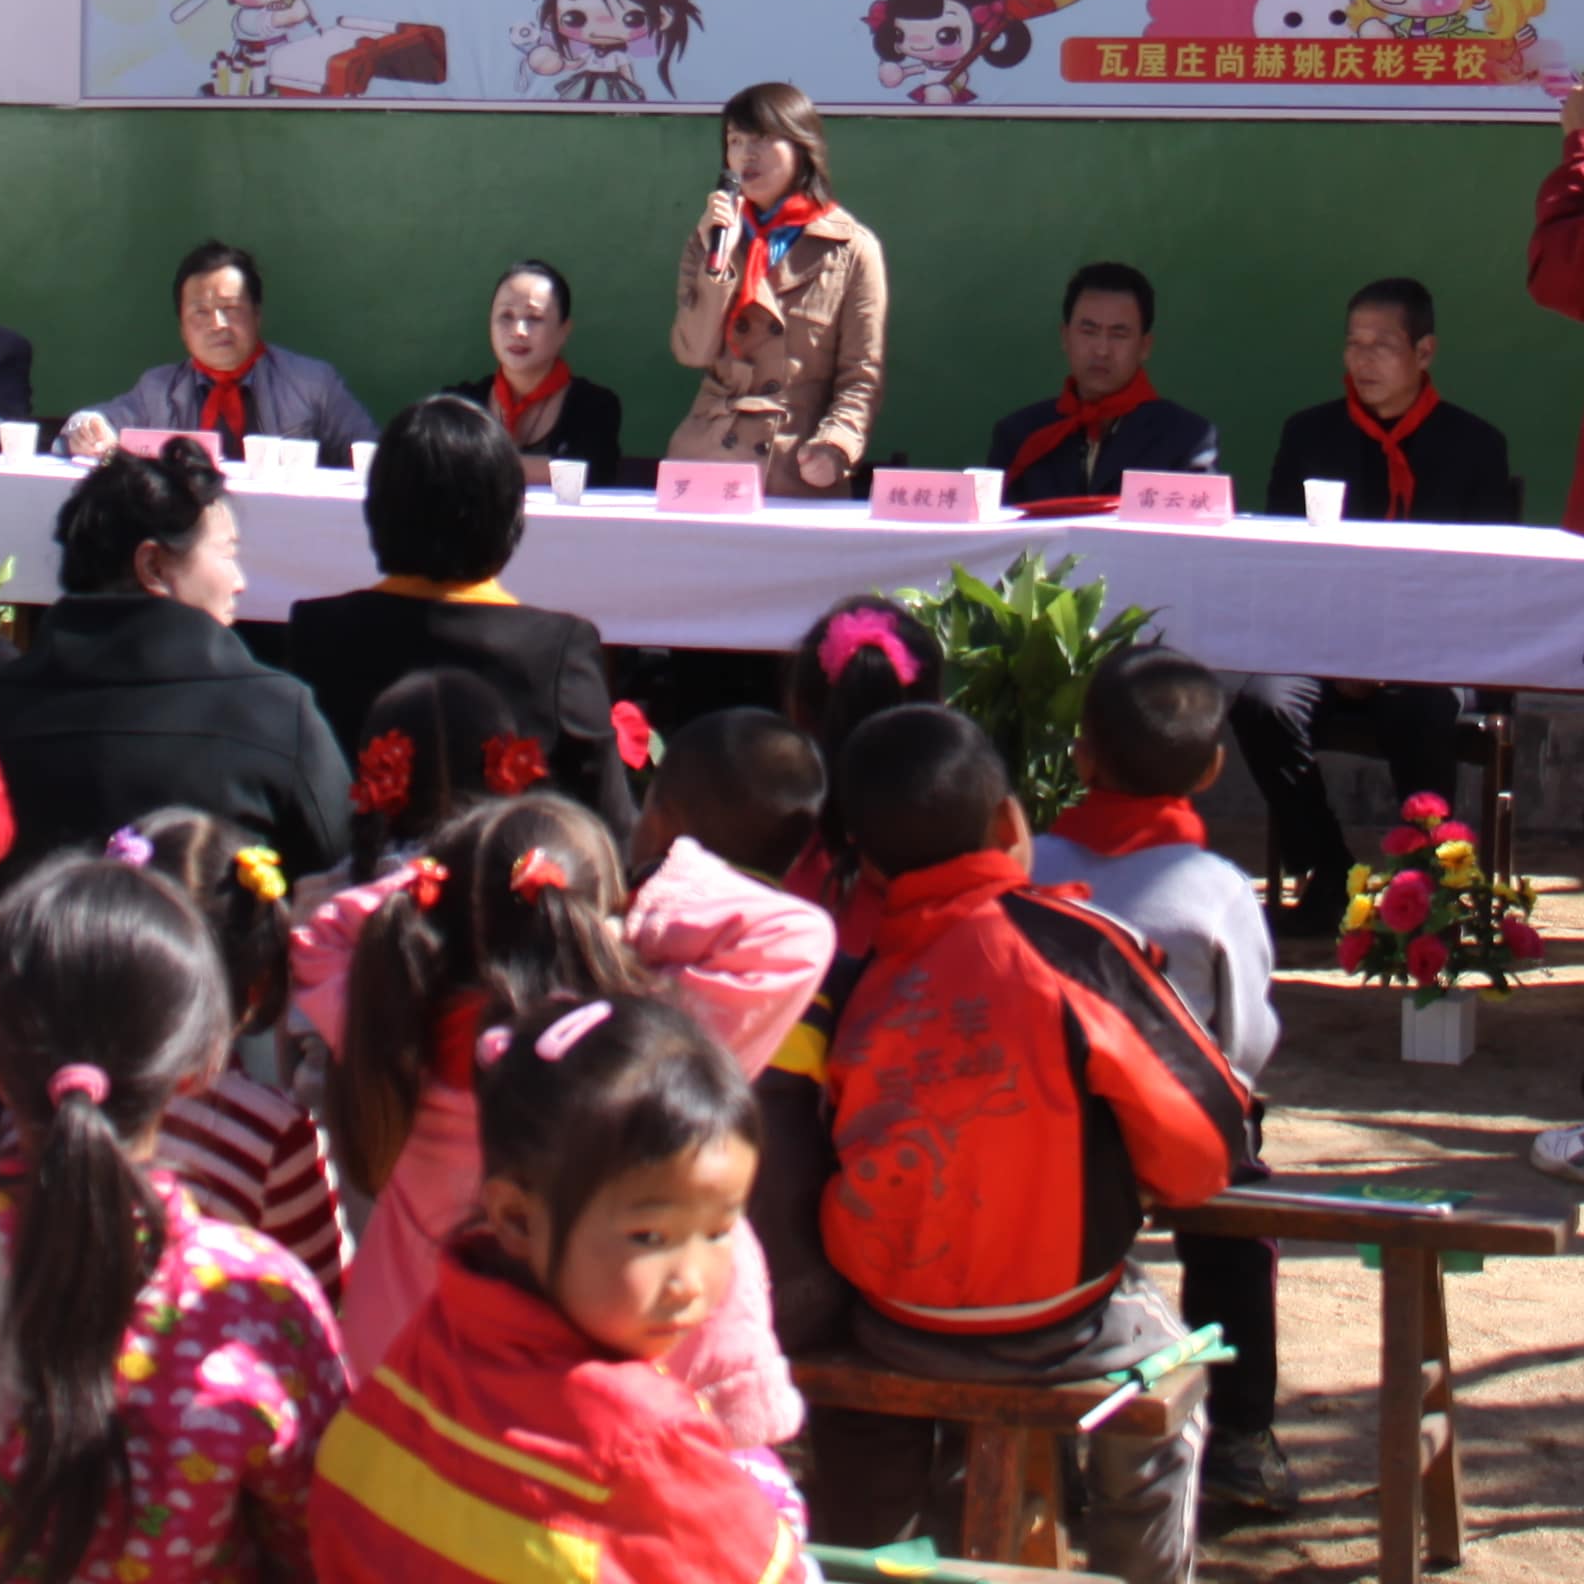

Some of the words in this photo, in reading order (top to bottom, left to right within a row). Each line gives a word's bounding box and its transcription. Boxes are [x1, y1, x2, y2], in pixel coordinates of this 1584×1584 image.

[1098, 43, 1487, 80] 瓦屋庄尚赫姚庆彬学校
